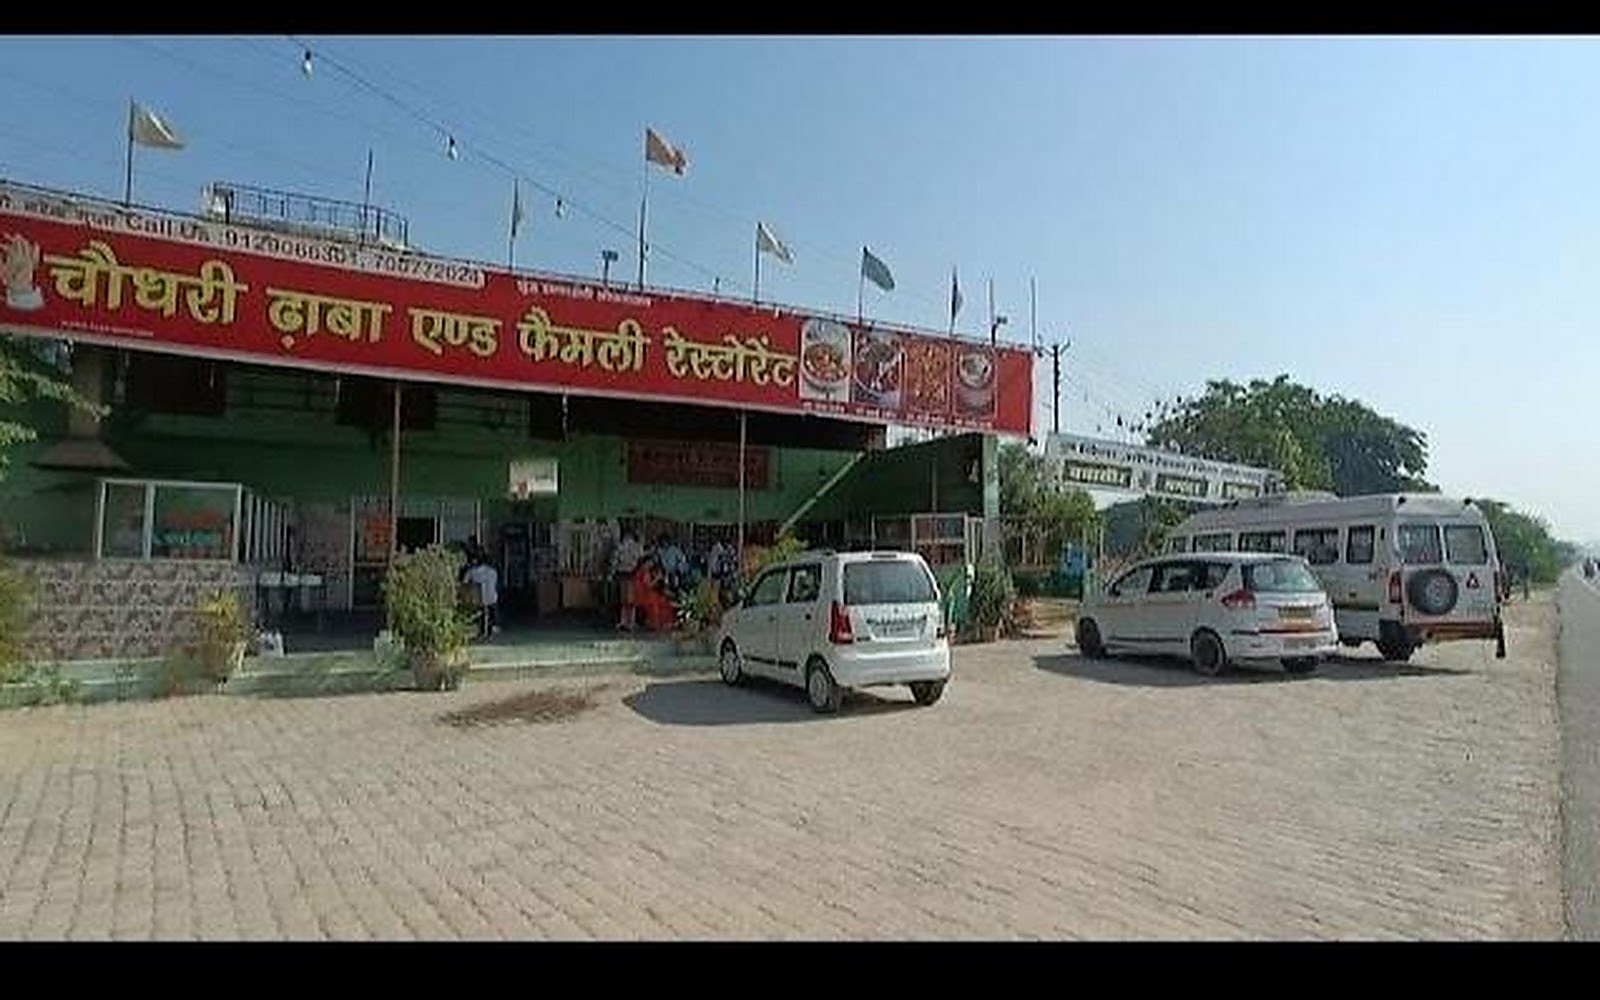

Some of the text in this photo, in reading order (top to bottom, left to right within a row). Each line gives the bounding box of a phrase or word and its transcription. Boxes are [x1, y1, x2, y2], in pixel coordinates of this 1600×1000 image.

[126, 211, 172, 237] Call
[43, 240, 797, 387] चौधरी ढ़ाबा एण्ड फैमली रेस्टोरेंट
